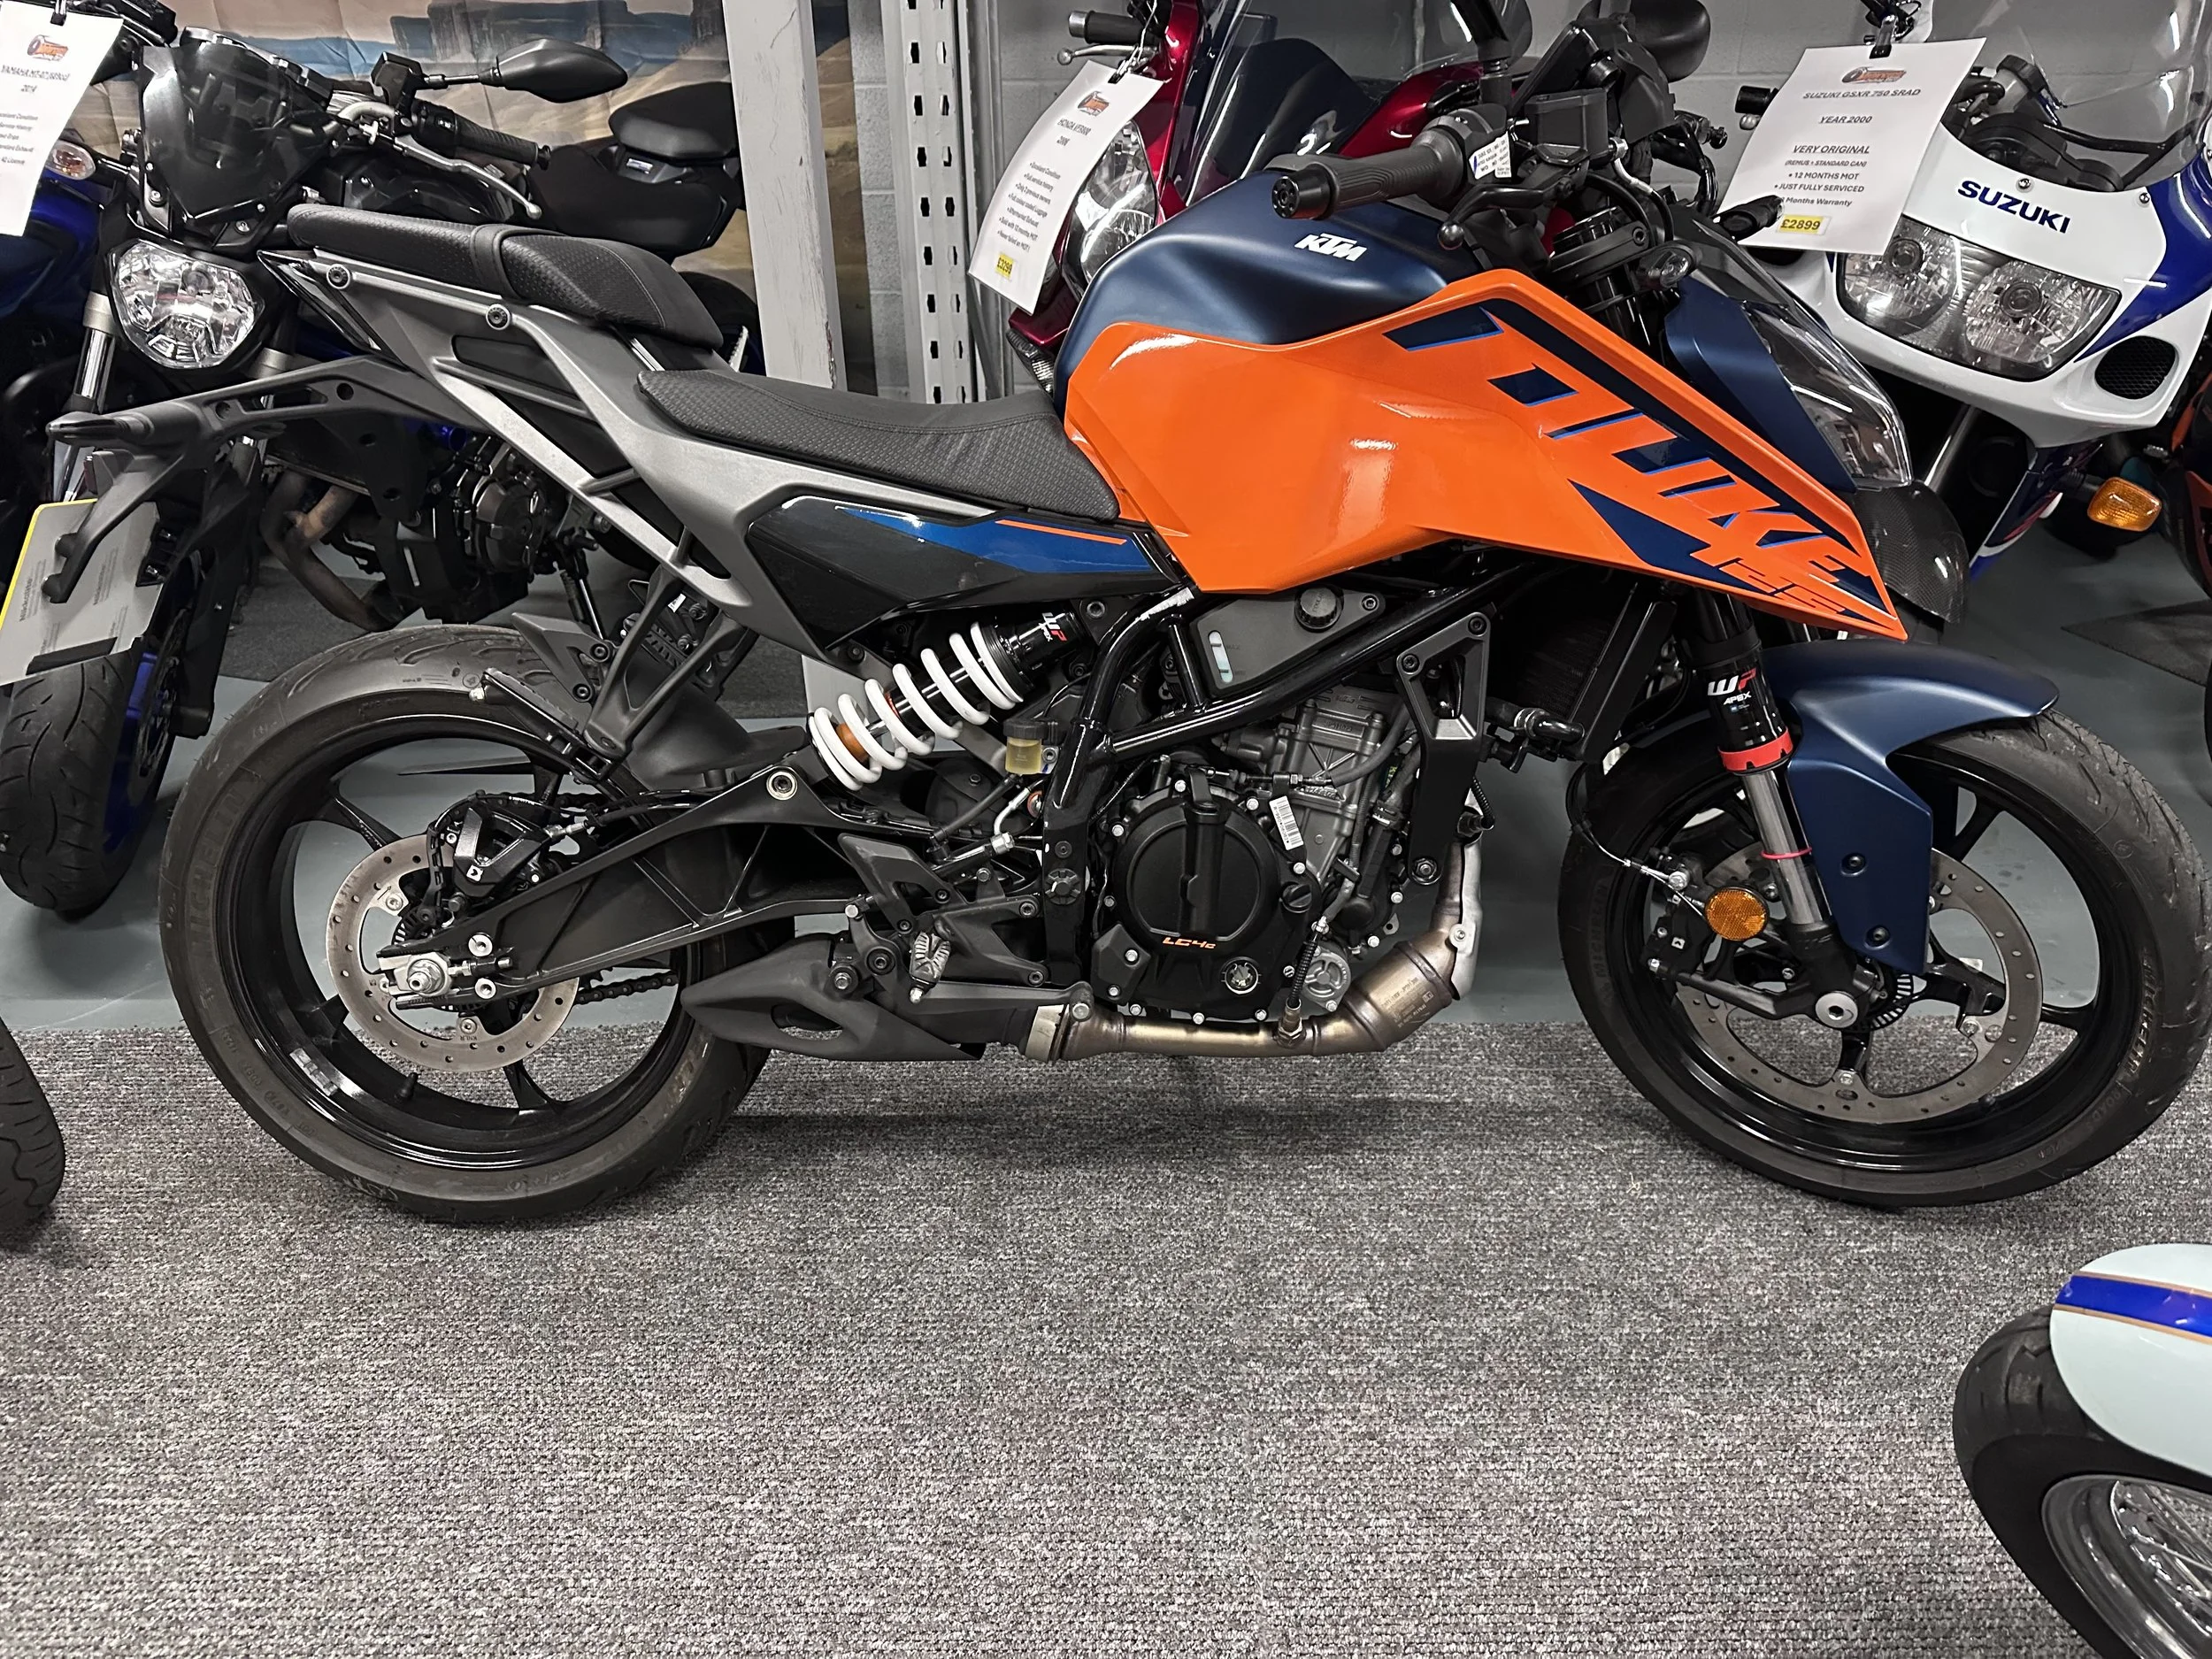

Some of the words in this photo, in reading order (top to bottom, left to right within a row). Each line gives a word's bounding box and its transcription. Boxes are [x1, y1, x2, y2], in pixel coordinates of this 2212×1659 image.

[1793, 145, 1820, 154] VERY
[1820, 145, 1870, 154] ORIGINAL
[1816, 198, 1853, 207] Warranty
[1958, 180, 2070, 234] SUZUKI
[1780, 219, 1821, 230] £2899
[1294, 232, 1367, 261] KTM
[1707, 667, 1757, 696] WP
[1724, 691, 1752, 705] APEX
